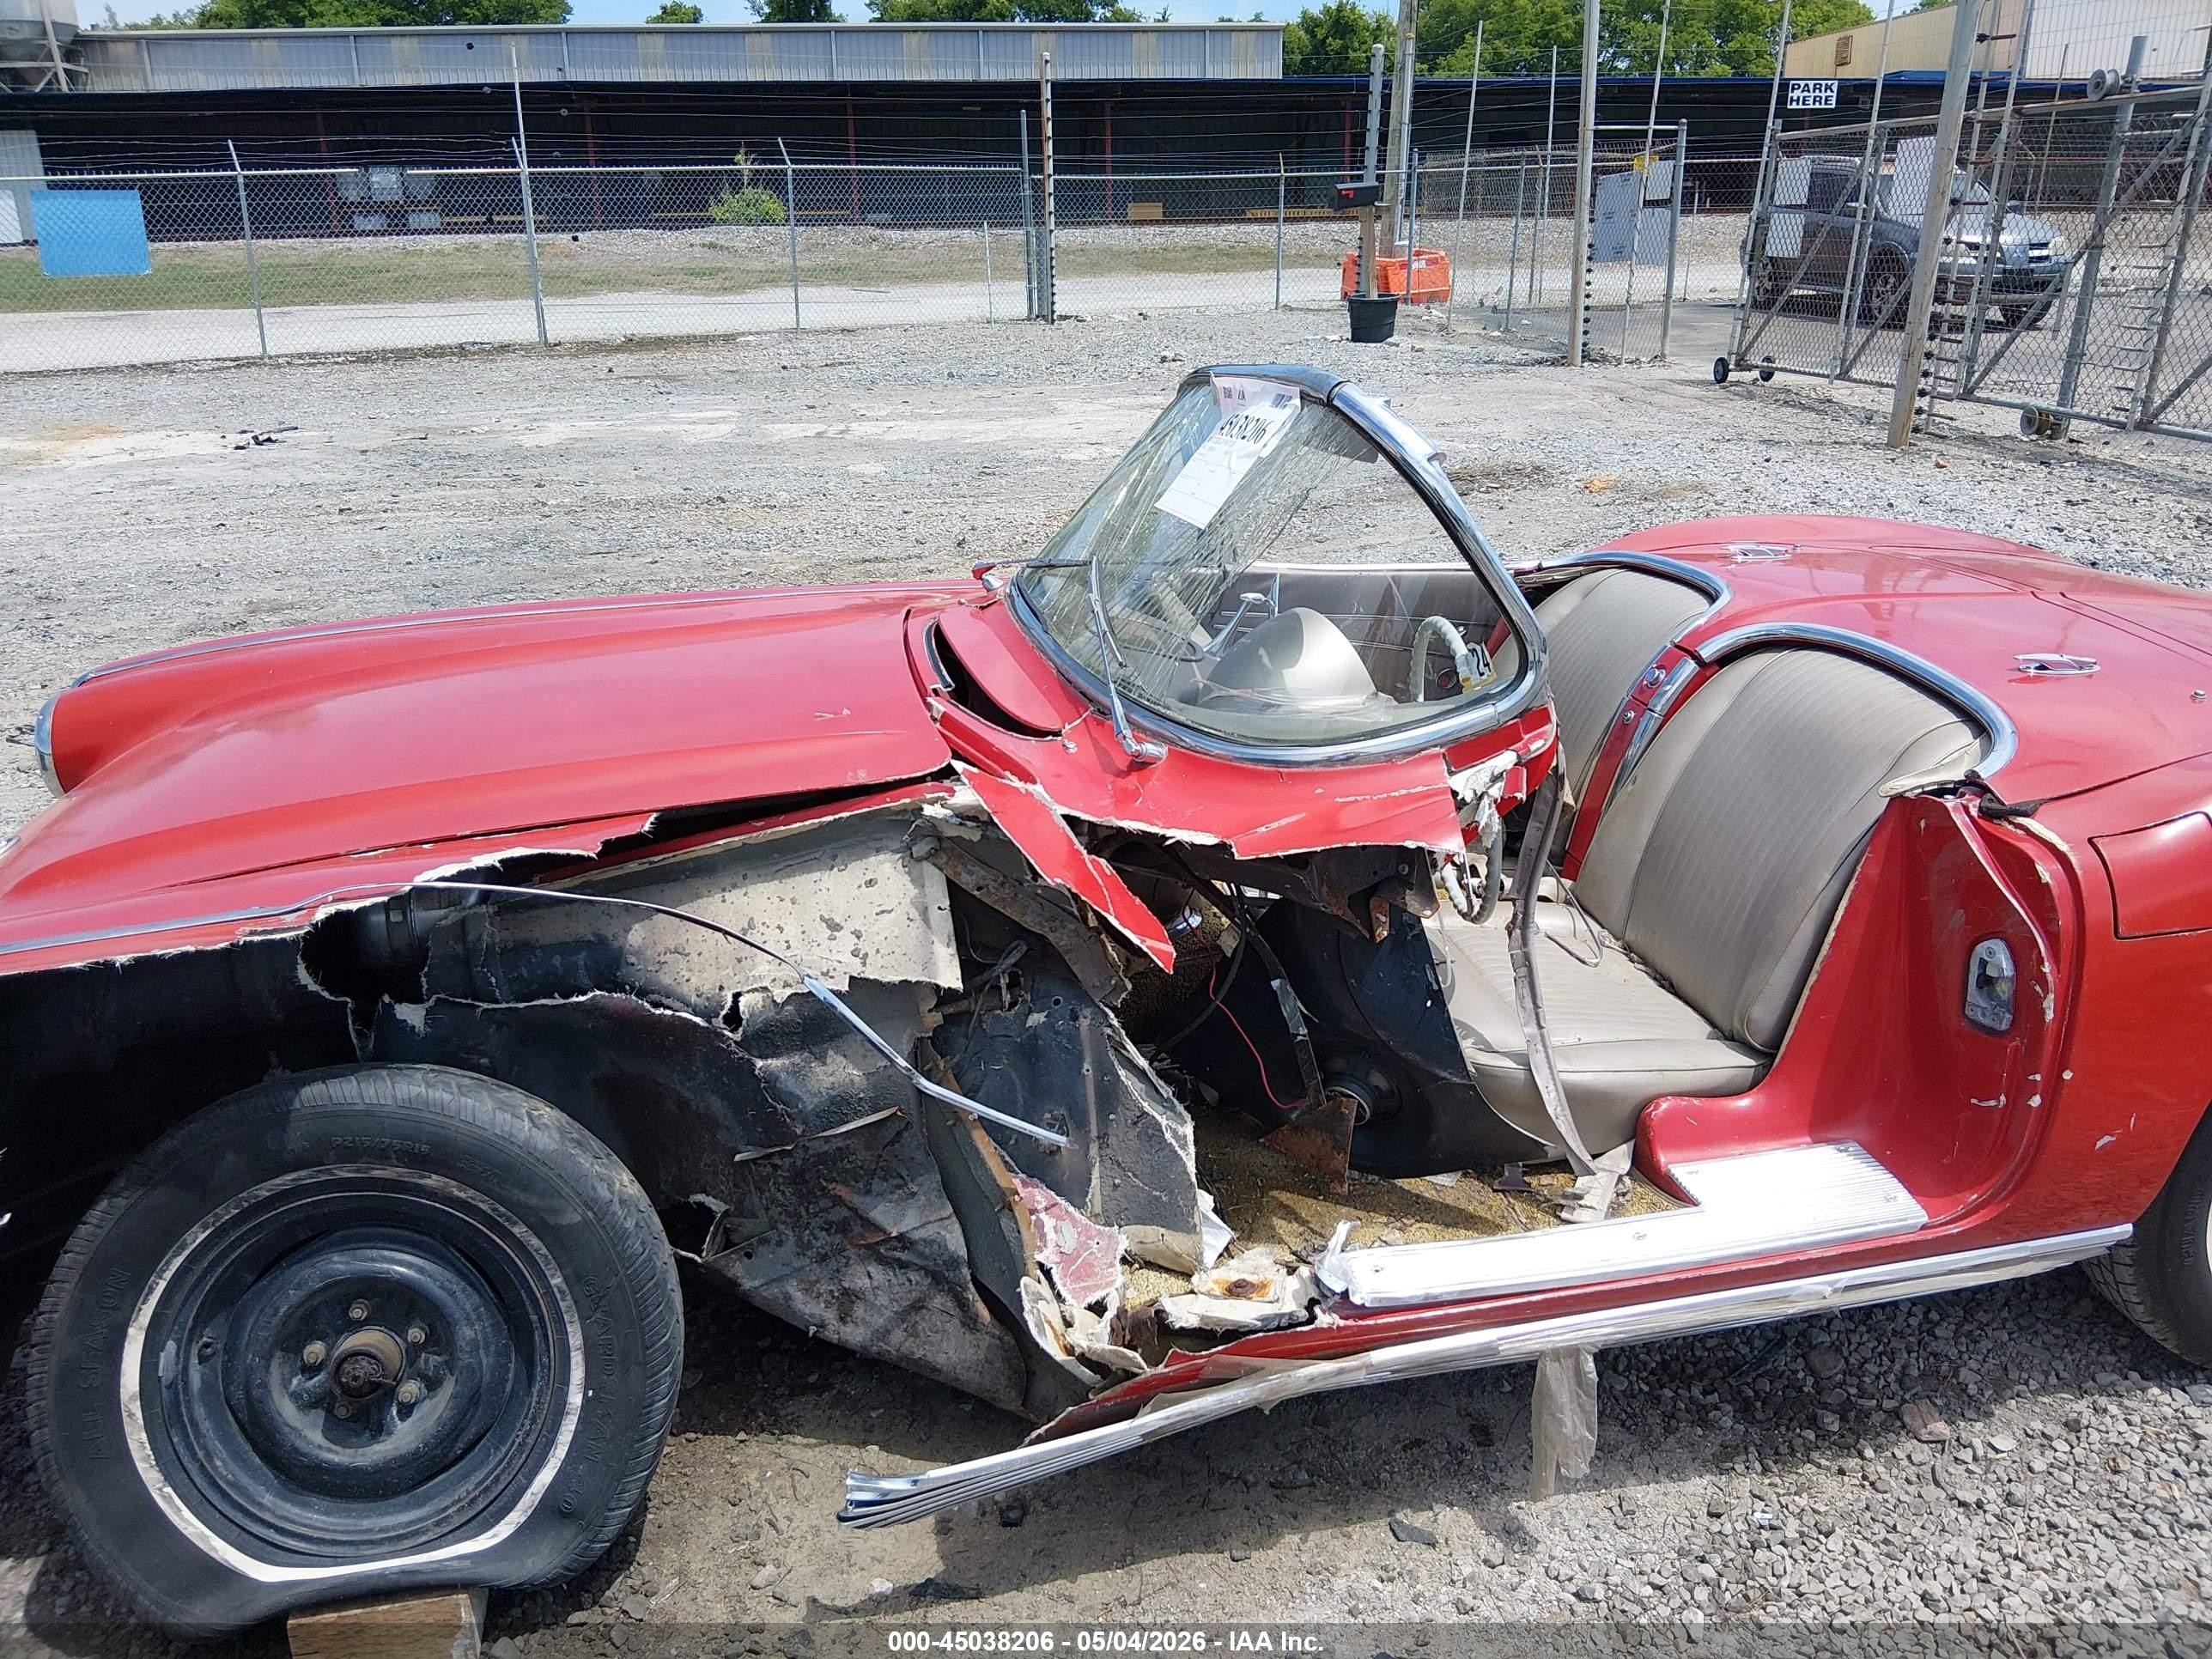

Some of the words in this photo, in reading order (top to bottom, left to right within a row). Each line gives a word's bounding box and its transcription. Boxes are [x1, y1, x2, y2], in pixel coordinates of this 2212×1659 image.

[1790, 82, 1836, 94] PARK
[1789, 94, 1834, 106] HERE
[1468, 645, 1492, 678] 24
[330, 1135, 434, 1156] P215/75R15
